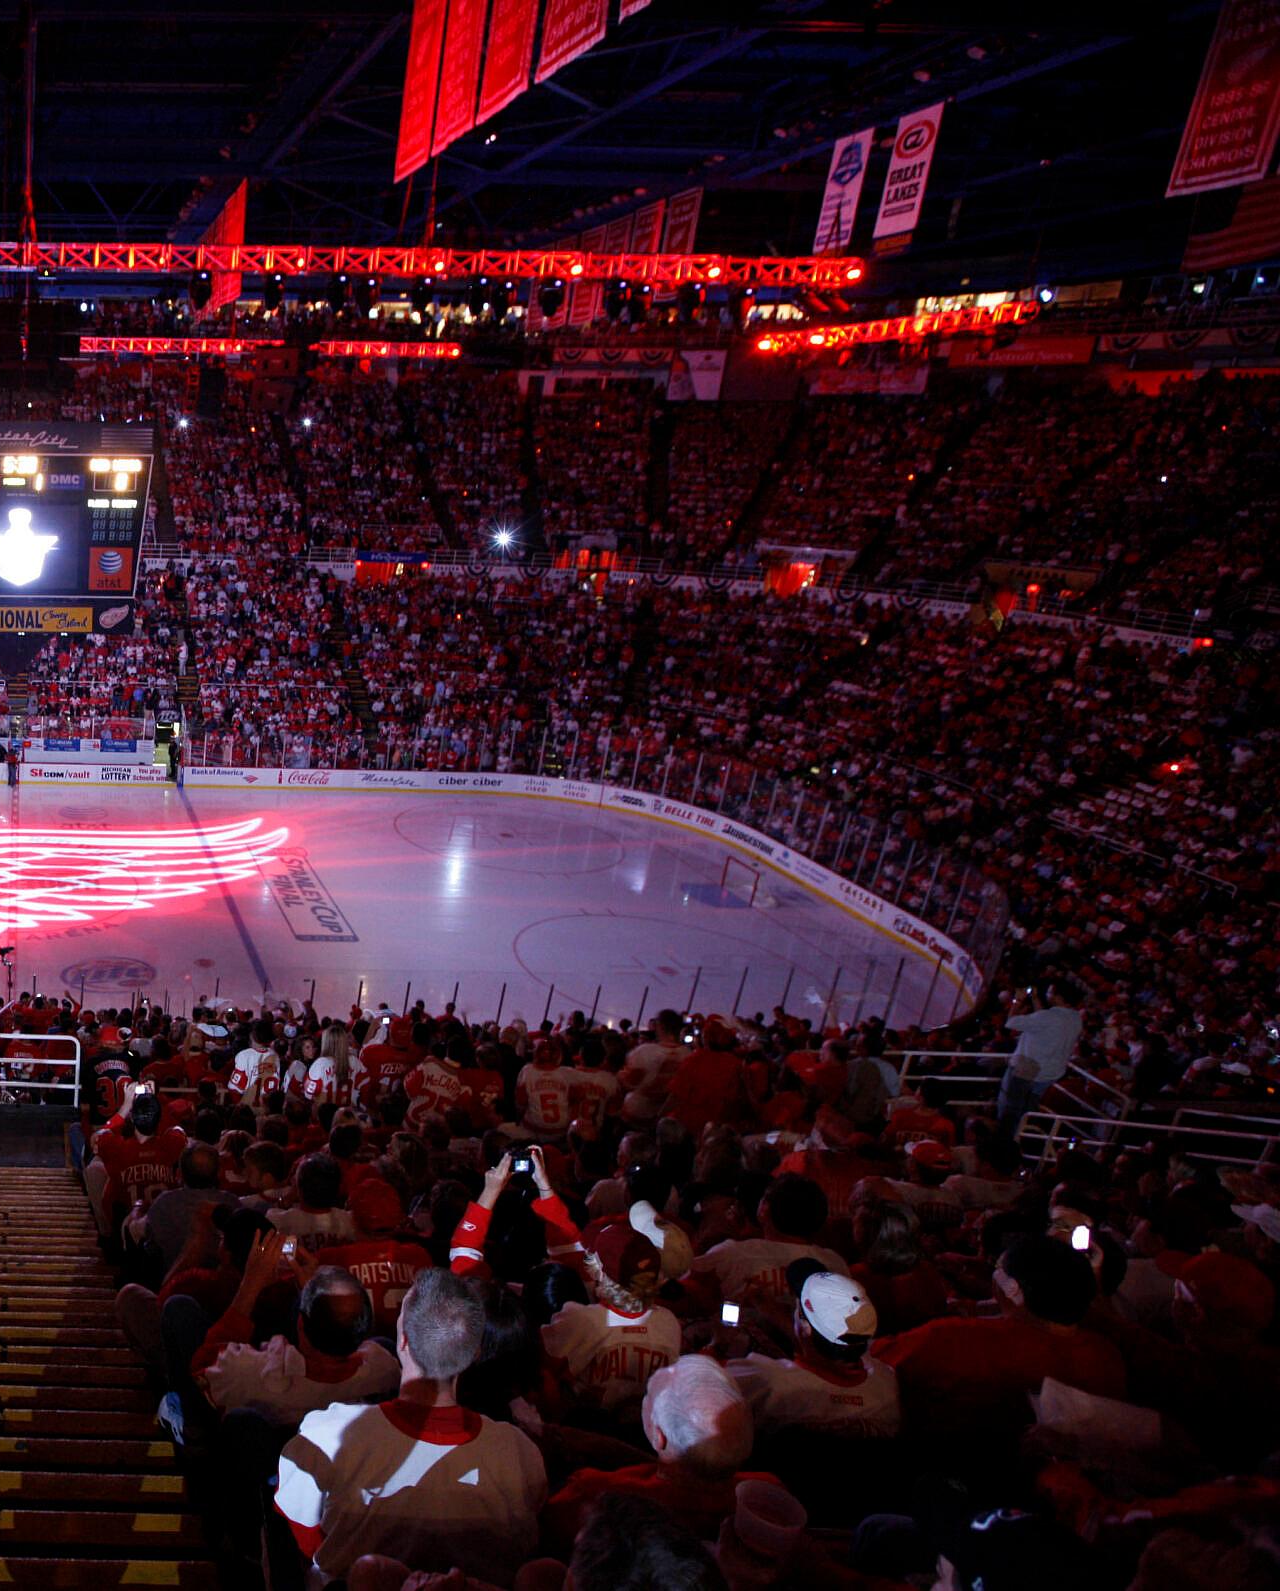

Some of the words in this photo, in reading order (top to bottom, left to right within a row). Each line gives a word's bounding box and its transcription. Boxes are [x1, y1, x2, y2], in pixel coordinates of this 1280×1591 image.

[888, 161, 926, 187] GREAT
[884, 182, 921, 206] LAKES
[988, 350, 1035, 362] Detroit
[1038, 350, 1074, 361] News
[50, 475, 80, 485] DMC
[101, 773, 131, 781] LOTTERY
[216, 769, 244, 777] America
[288, 771, 330, 785] Coca-Cola
[438, 776, 468, 785] ciber
[473, 776, 504, 786] ciber
[664, 805, 692, 820] BELLE
[696, 814, 715, 828] TIRE
[271, 874, 305, 908] FINAL
[279, 857, 328, 906] STANLEY
[310, 905, 343, 933] CUP
[539, 1093, 561, 1123] 5
[120, 1163, 176, 1184] YZERMAN
[588, 1346, 669, 1384] MALTB
